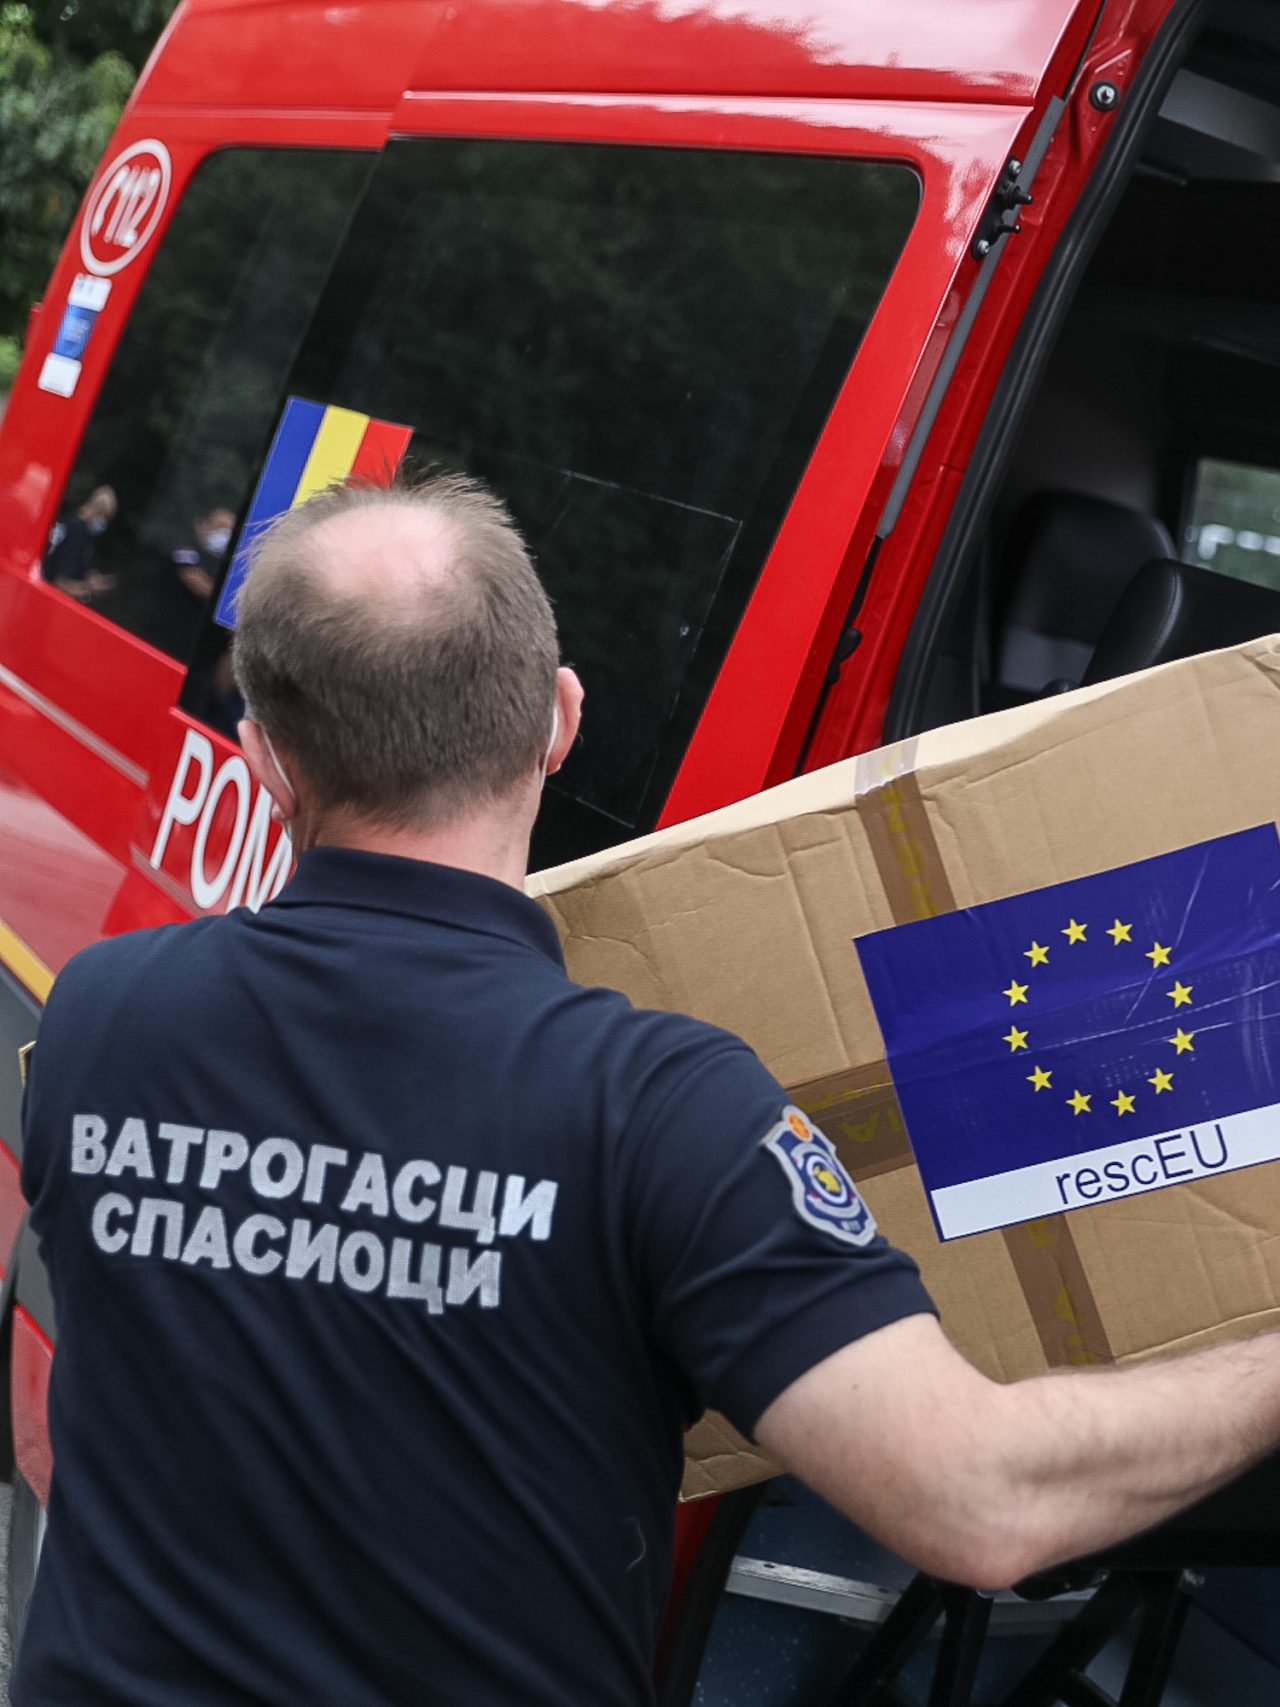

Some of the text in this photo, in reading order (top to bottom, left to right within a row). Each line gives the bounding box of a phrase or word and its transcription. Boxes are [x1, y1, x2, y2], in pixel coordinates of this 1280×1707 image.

[71, 1114, 558, 1243] ВАТРОГАСЦИ
[1055, 1123, 1229, 1205] rescEU
[91, 1193, 501, 1314] СПАСИОЦИ
